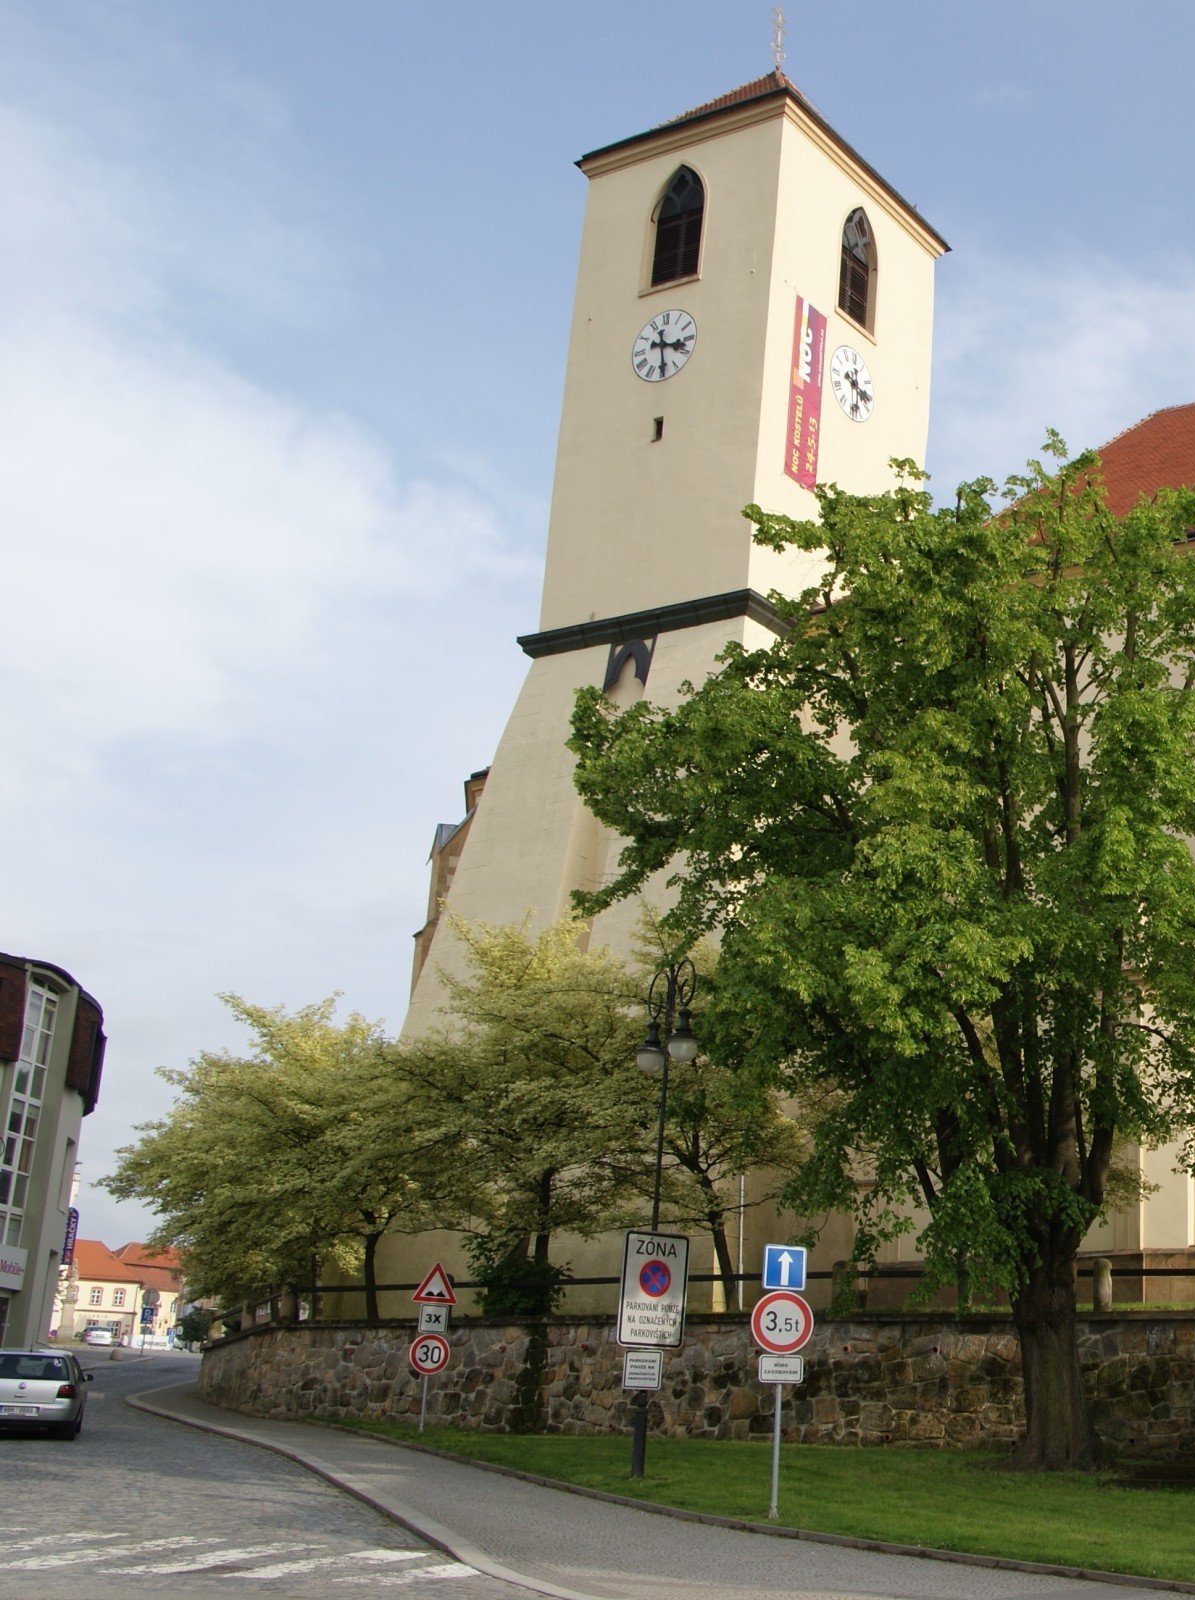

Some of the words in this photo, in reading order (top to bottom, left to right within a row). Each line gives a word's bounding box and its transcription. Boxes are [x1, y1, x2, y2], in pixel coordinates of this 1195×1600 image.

[791, 448, 800, 473] NOC
[636, 1237, 677, 1258] ZÓNA
[626, 1301, 658, 1312] PARKOVÁNÍ
[661, 1304, 680, 1314] POUZE
[627, 1316, 636, 1324] NA
[418, 1344, 442, 1364] 30
